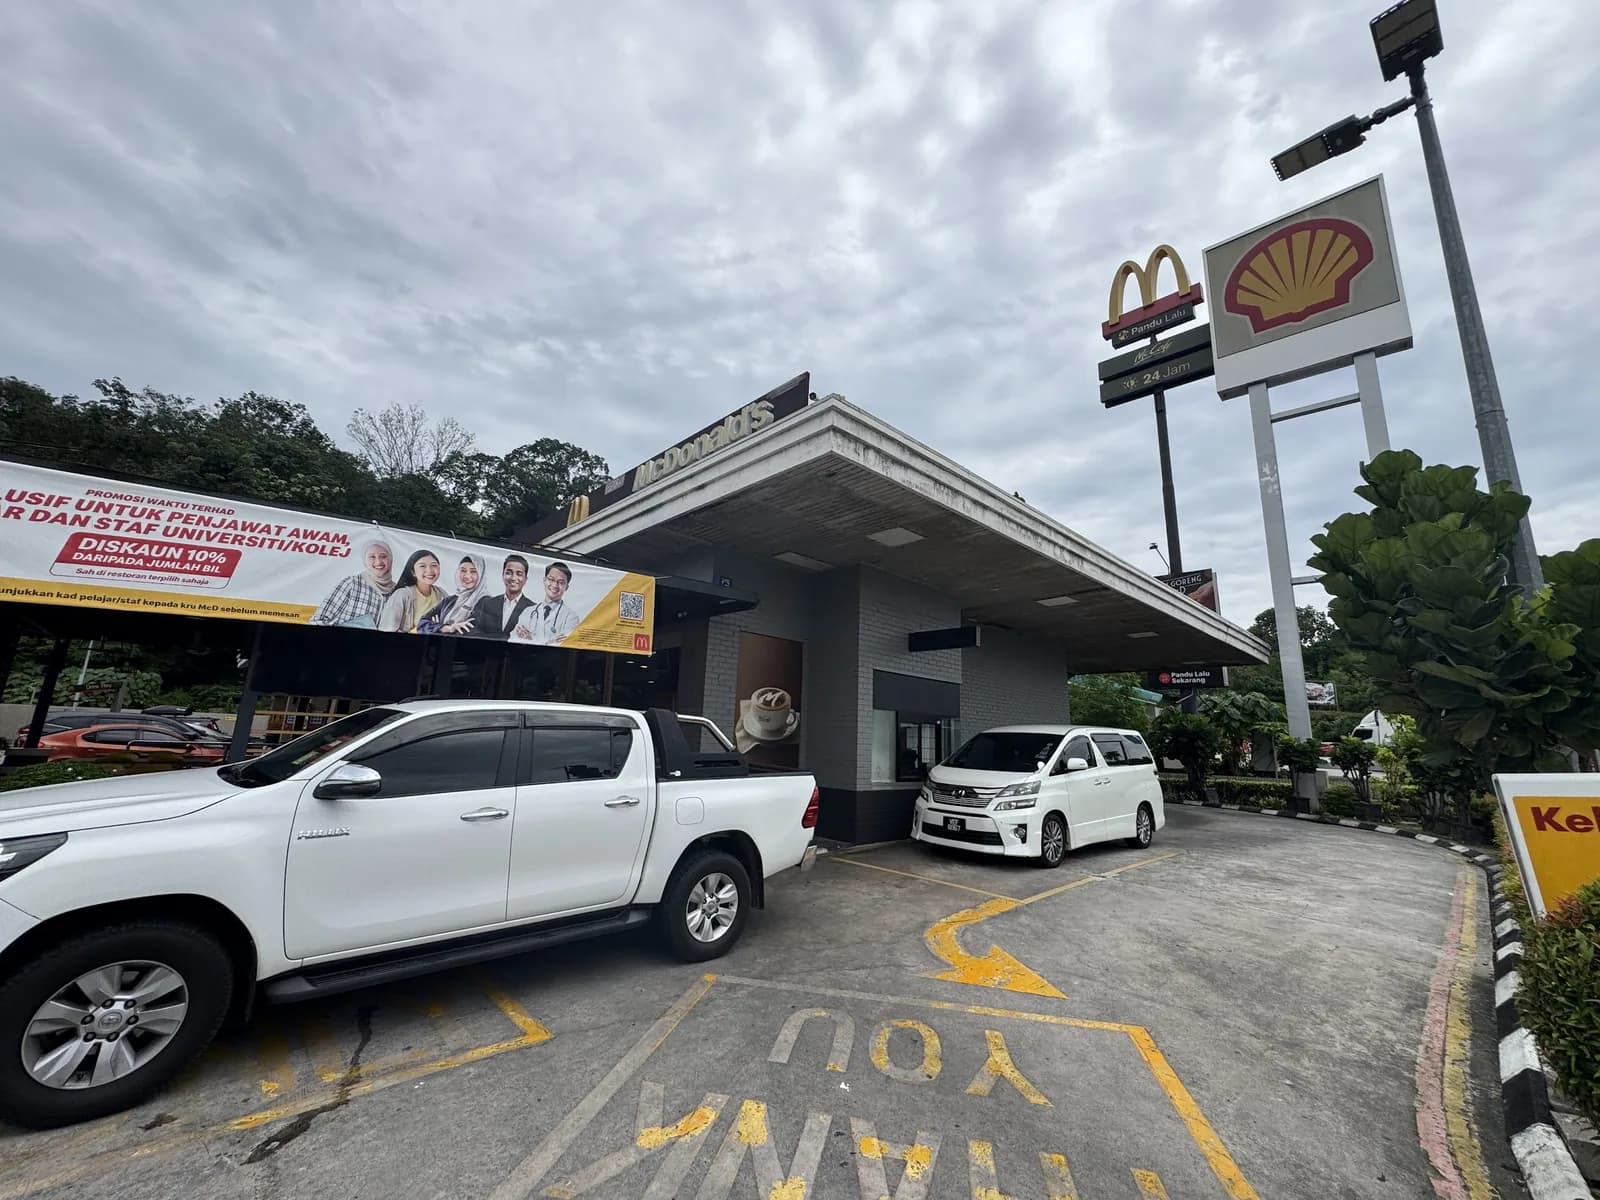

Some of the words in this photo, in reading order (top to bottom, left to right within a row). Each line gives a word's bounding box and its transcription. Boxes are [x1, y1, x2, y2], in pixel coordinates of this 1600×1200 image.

[1131, 316, 1162, 335] Pandu
[1165, 308, 1186, 322] Lalu
[1143, 370, 1161, 384] 24
[1163, 362, 1191, 378] Jam
[632, 400, 775, 492] McDonald's
[86, 489, 144, 503] PROMOSI
[147, 498, 190, 509] WAKTU
[191, 504, 235, 516] TERHAD
[0, 489, 72, 508] USIF
[75, 499, 164, 521] UNTUK
[167, 511, 287, 537] PENJAWAT
[287, 528, 351, 547] AWAM,
[29, 509, 91, 528] DAN
[94, 517, 160, 535] STAF
[162, 525, 352, 558] UNIVERSITI/KOLEJ
[72, 553, 144, 566] DARIPADA
[146, 560, 200, 571] JUMLAH
[202, 565, 221, 574] BIL
[78, 538, 181, 560] DISKAUN
[188, 549, 226, 564] 10%
[75, 568, 95, 576] Sah
[97, 569, 106, 577] di
[107, 571, 147, 580] restoran
[149, 573, 180, 583] terpilih
[182, 576, 209, 585] sahaja
[1170, 575, 1202, 587] GORENG
[56, 591, 77, 600] kad
[79, 594, 141, 606] pelajar/staf
[143, 599, 178, 609] kepada
[180, 602, 196, 610] kru
[198, 604, 219, 612] McD
[220, 606, 258, 615] sebelum
[259, 610, 300, 618] memesan
[767, 1008, 1054, 1107] YOU
